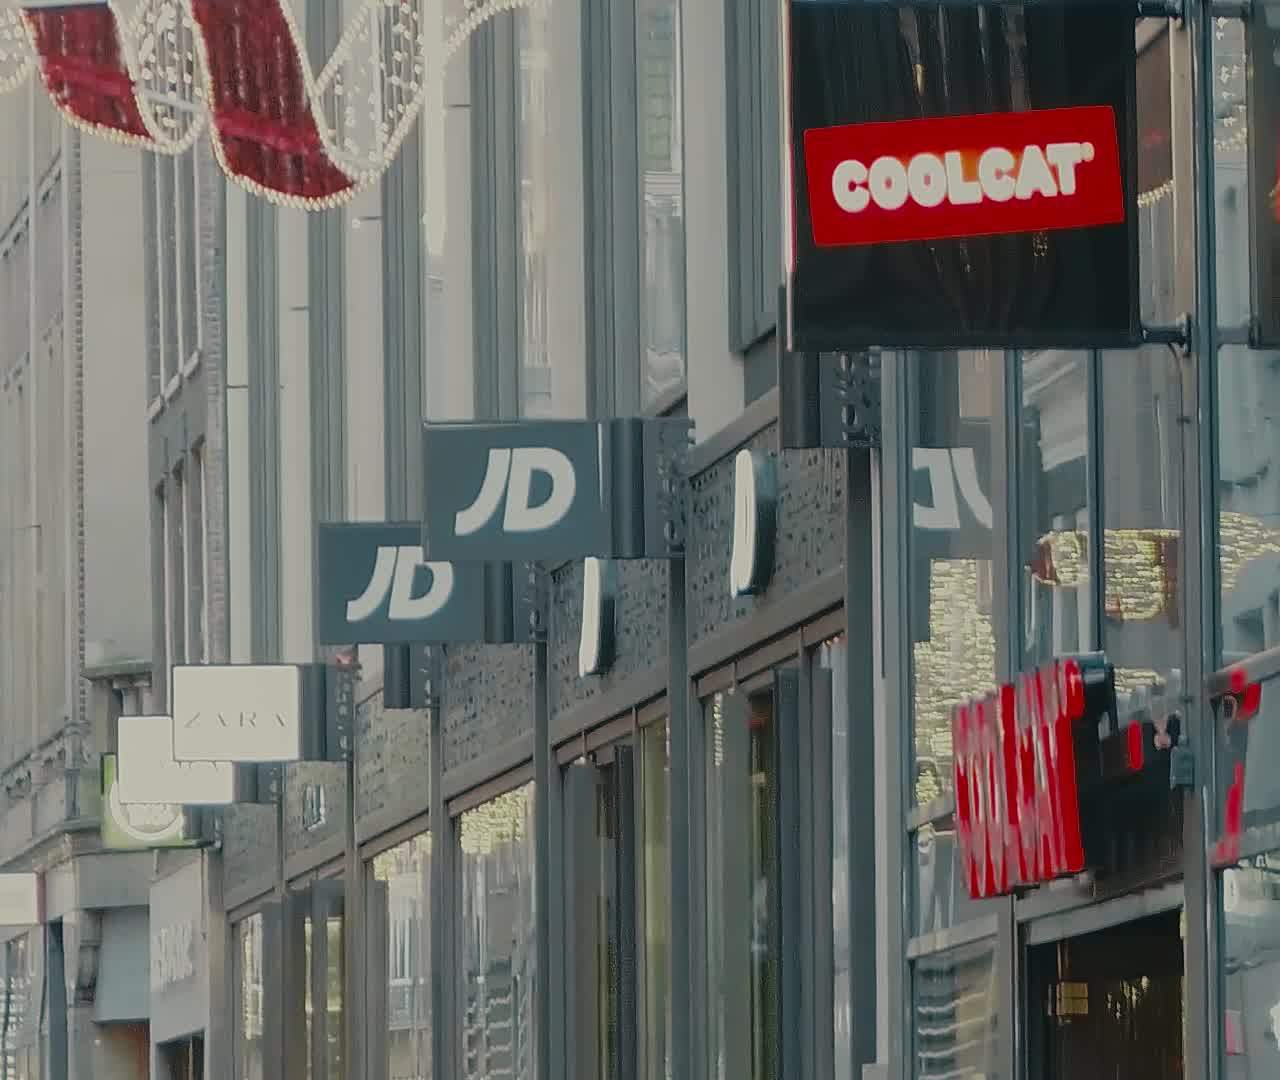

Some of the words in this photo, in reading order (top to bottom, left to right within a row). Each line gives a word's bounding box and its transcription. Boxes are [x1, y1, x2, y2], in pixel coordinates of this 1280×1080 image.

[832, 143, 1082, 213] COOLCAT
[455, 447, 576, 536] JD
[346, 545, 455, 622] JD
[184, 711, 289, 729] ZARA
